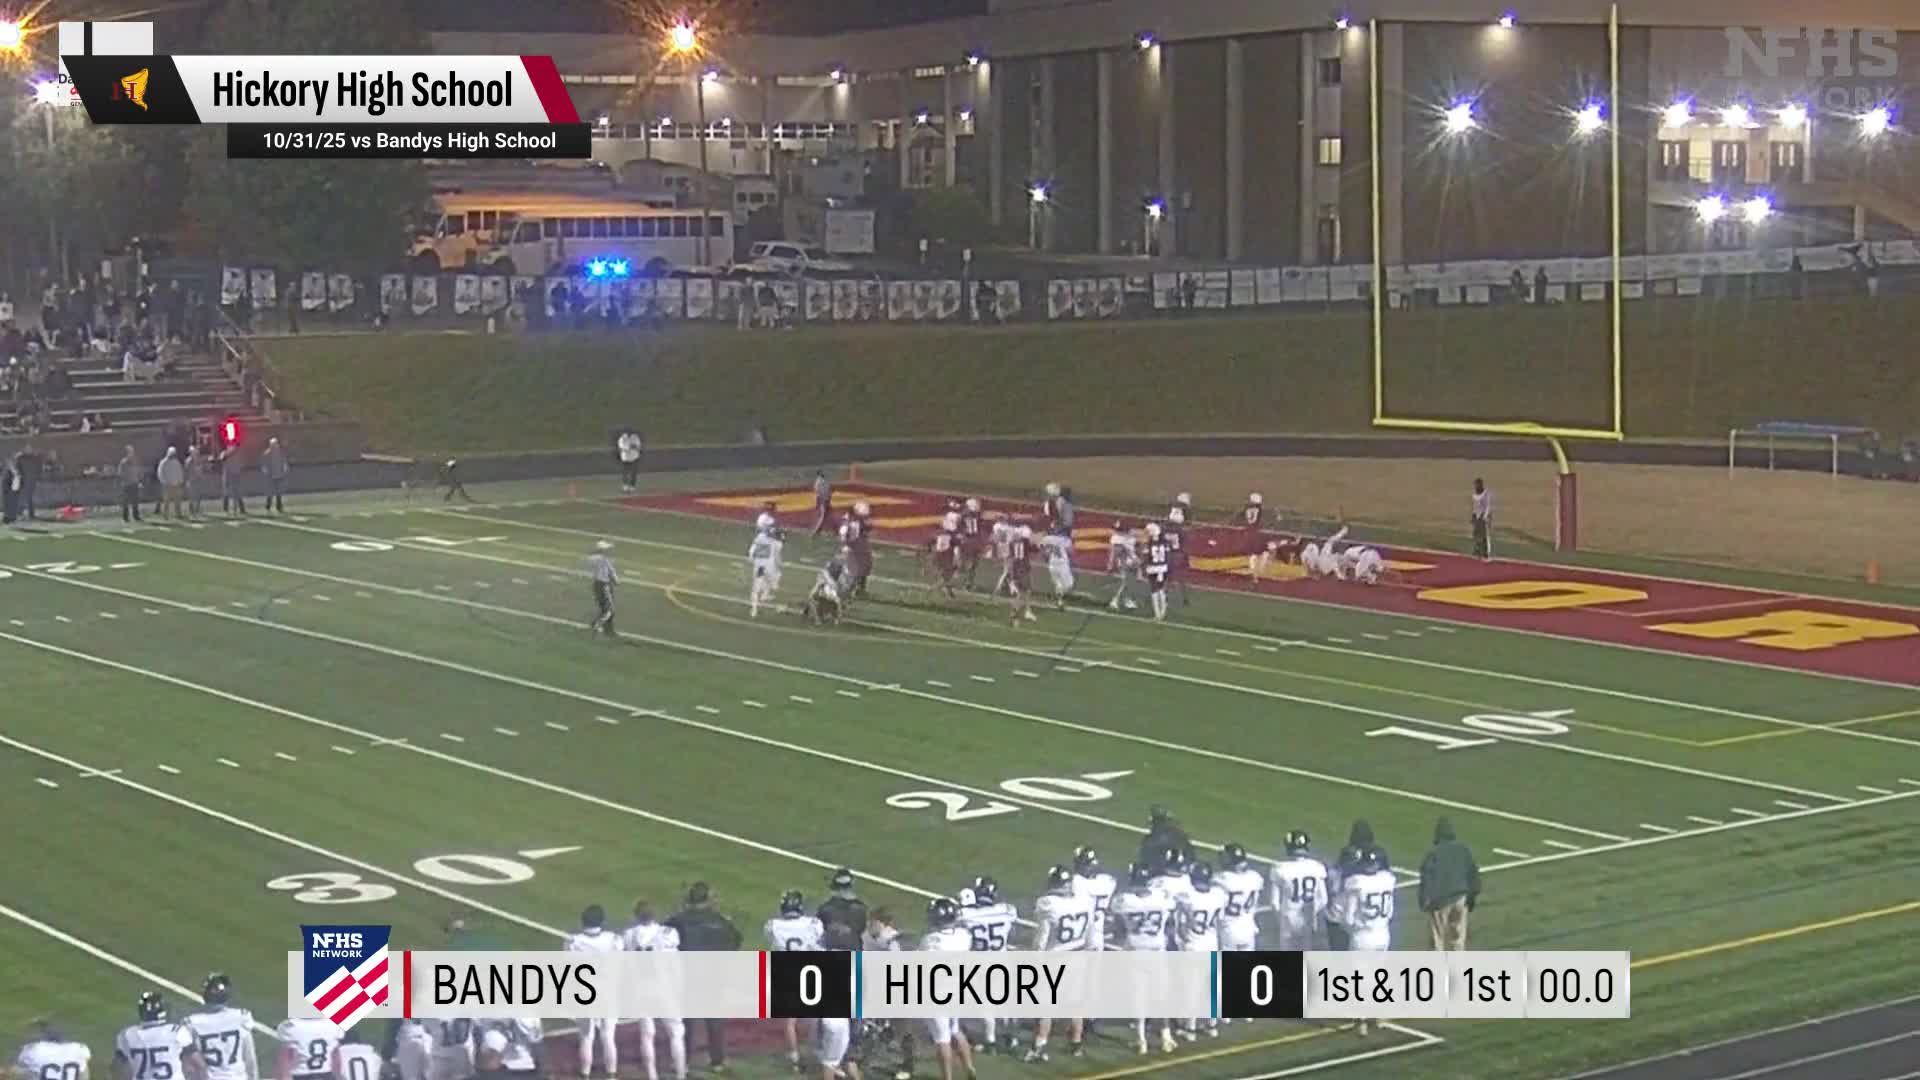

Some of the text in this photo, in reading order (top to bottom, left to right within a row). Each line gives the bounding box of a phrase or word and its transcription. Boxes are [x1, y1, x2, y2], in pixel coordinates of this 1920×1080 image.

[1365, 713, 1570, 750] 10
[886, 776, 1114, 822] 20
[266, 854, 536, 904] 30
[1291, 876, 1316, 903] 18
[1363, 891, 1392, 919] 50
[972, 922, 1005, 950] 65
[1058, 912, 1089, 943] 67
[130, 1047, 173, 1080] 75
[202, 1030, 241, 1068] 57
[308, 1039, 328, 1070] 8
